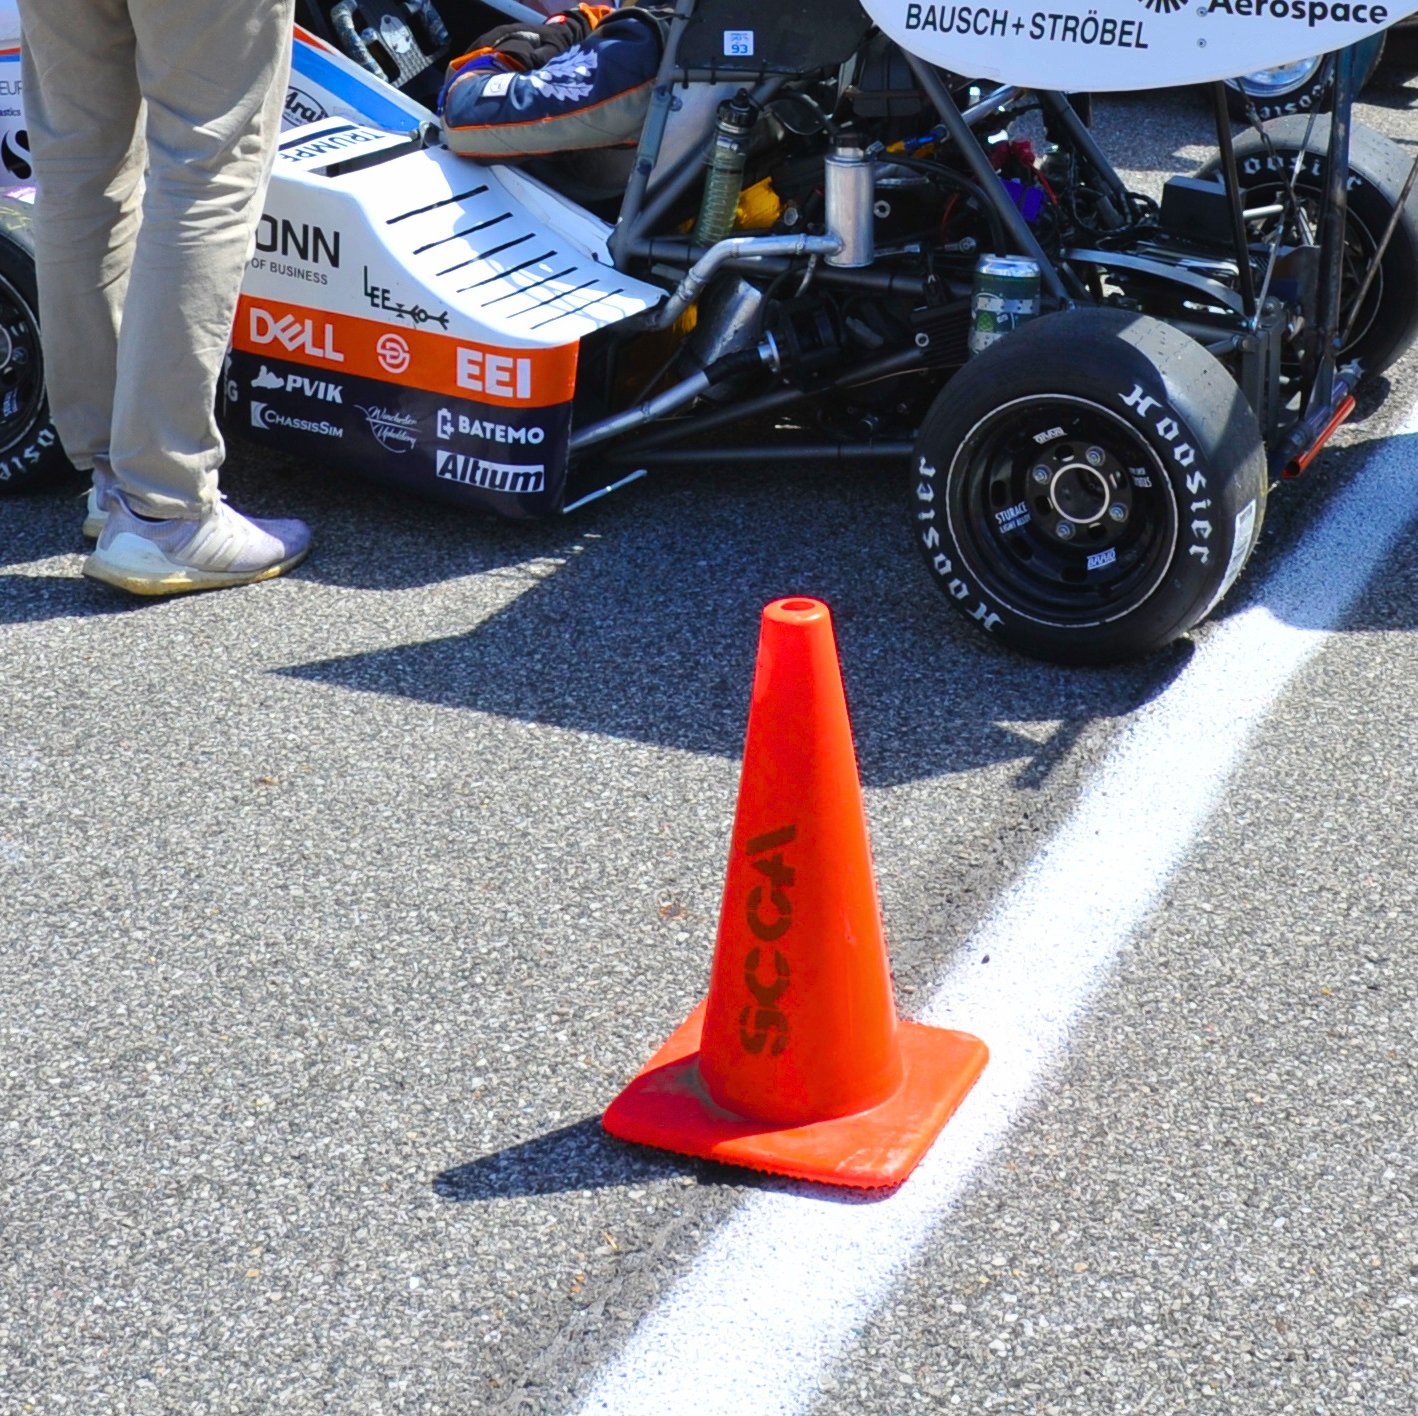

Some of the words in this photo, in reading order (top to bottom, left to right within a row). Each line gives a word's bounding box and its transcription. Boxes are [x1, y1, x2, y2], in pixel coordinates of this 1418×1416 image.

[905, 2, 1009, 35] BAUSCH
[1029, 10, 1149, 49] STRÖBEL
[731, 44, 748, 54] 93
[279, 131, 386, 162] TRUMPF
[256, 213, 339, 268] ONN
[251, 258, 267, 269] OF
[270, 262, 328, 285] BUSINESS
[250, 307, 344, 362] DELL
[285, 374, 343, 404] PVIK
[457, 346, 531, 399] EEI
[458, 415, 545, 444] BATEMO
[438, 454, 544, 491] Altium
[1119, 384, 1215, 565] Hoosier
[995, 501, 1028, 525] STURACE
[916, 456, 1006, 632] Hoosier
[739, 824, 797, 1057] SCCA
